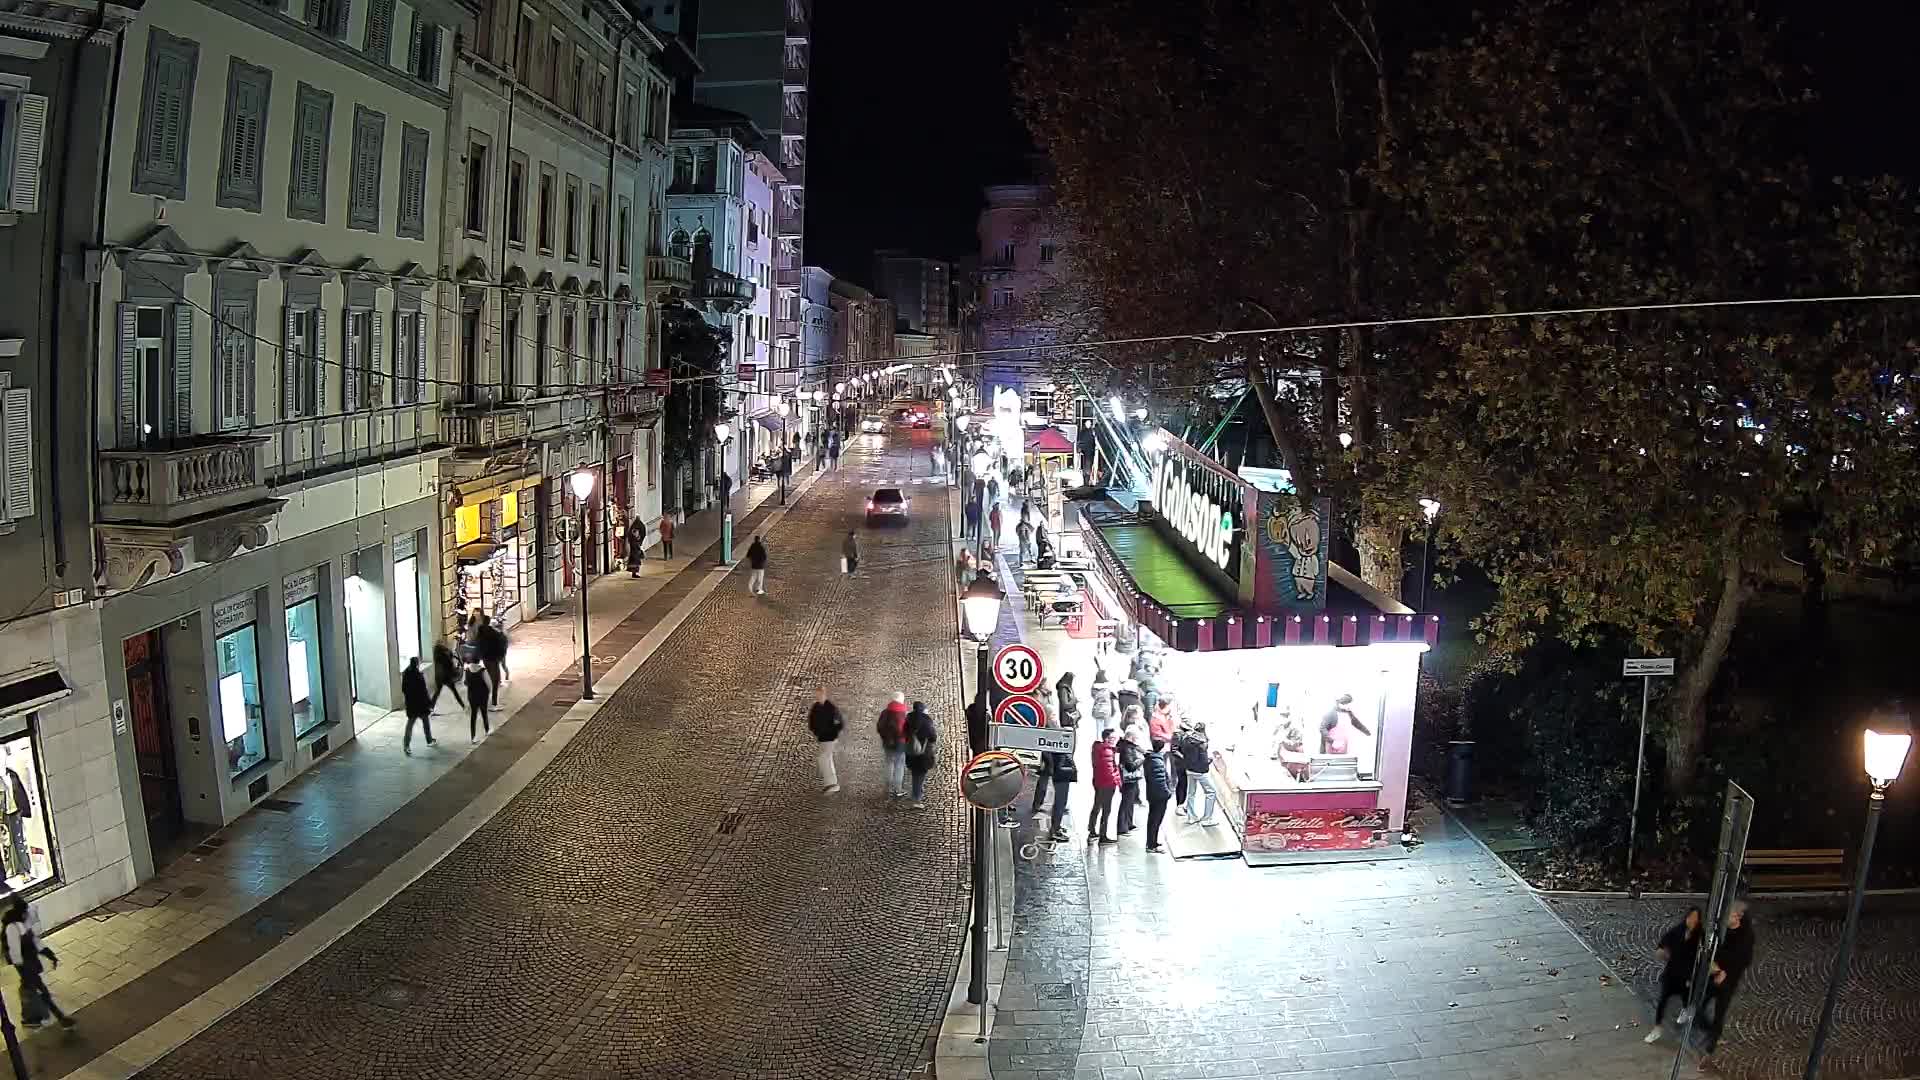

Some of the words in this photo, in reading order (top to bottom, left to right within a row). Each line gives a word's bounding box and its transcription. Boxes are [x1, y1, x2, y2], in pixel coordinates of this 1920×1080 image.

[1162, 459, 1233, 569] Golosone
[1005, 658, 1033, 680] 30
[1038, 737, 1069, 749] Dante
